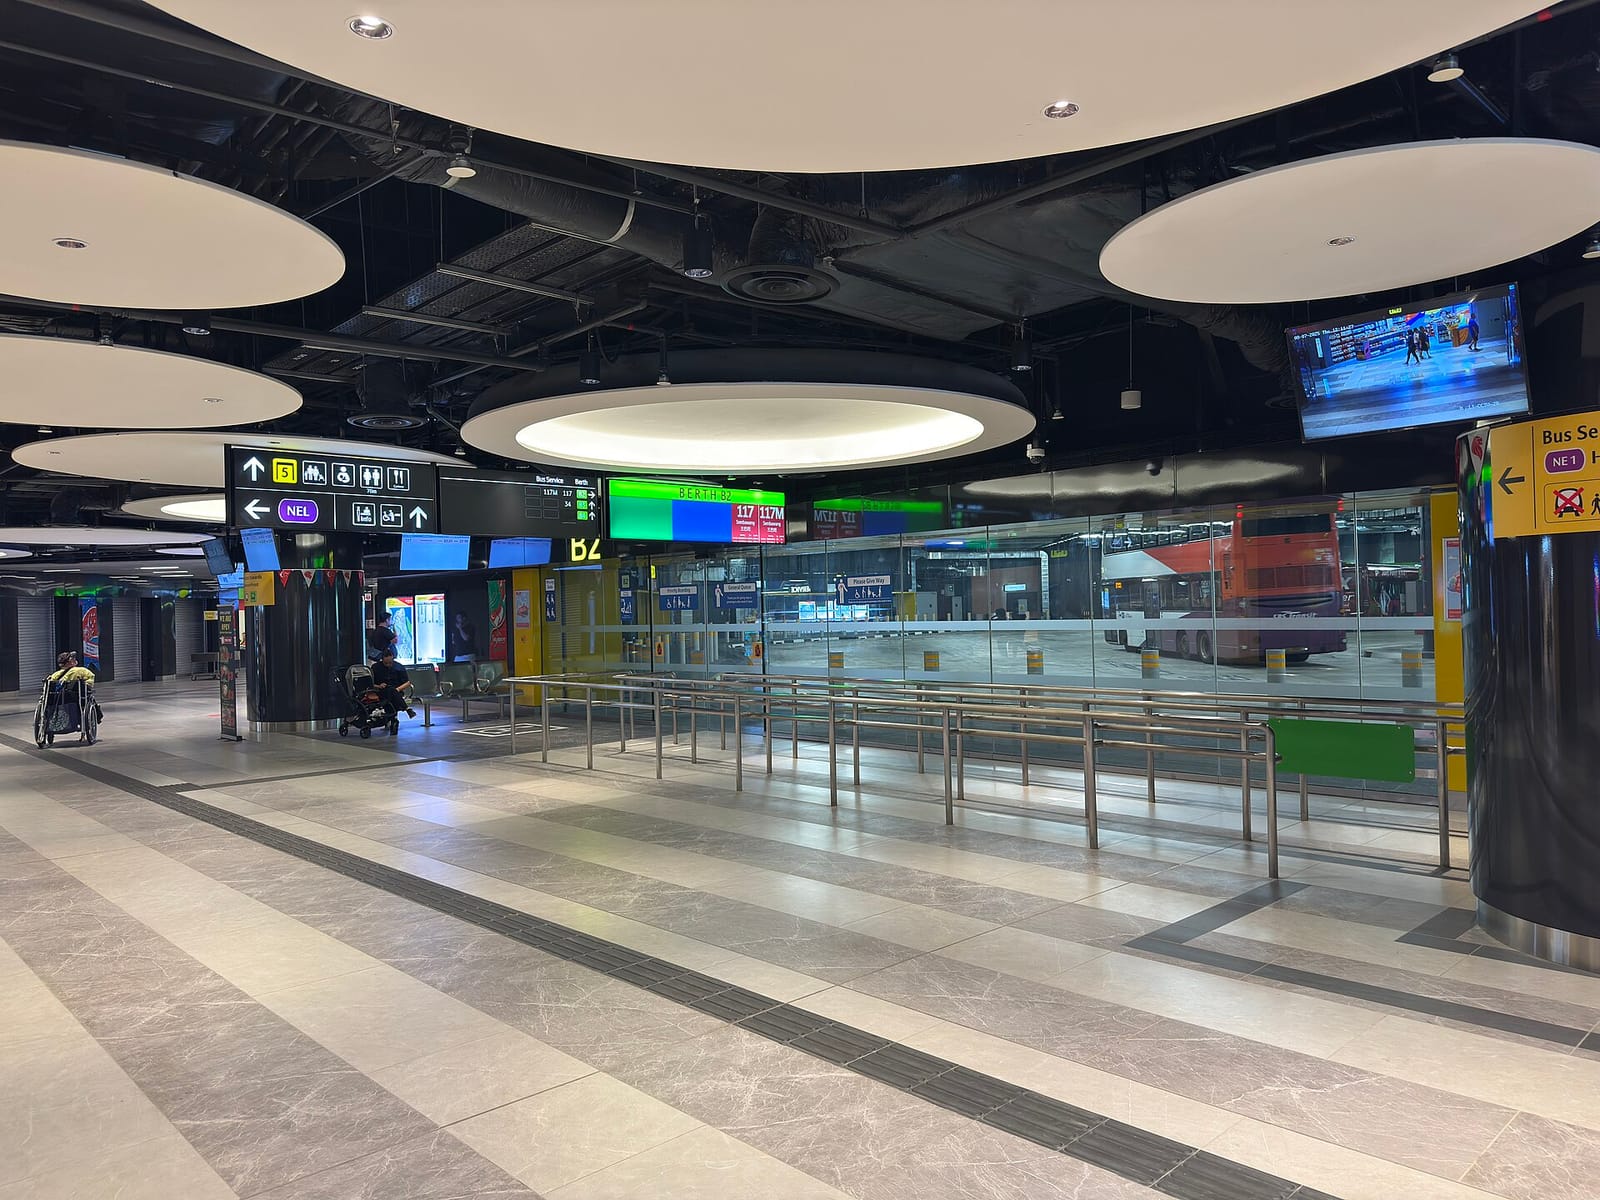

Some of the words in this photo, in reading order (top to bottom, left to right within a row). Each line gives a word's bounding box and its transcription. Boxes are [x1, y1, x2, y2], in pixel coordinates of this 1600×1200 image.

[1542, 430, 1572, 445] Bus
[1552, 456, 1568, 467] NE
[1570, 455, 1576, 465] 1
[282, 468, 289, 478] 5
[574, 478, 588, 486] Berth
[679, 488, 717, 500] BERTH
[720, 492, 732, 502] B2
[287, 506, 310, 517] NEL
[737, 505, 754, 518] 117
[760, 506, 784, 520] 117M
